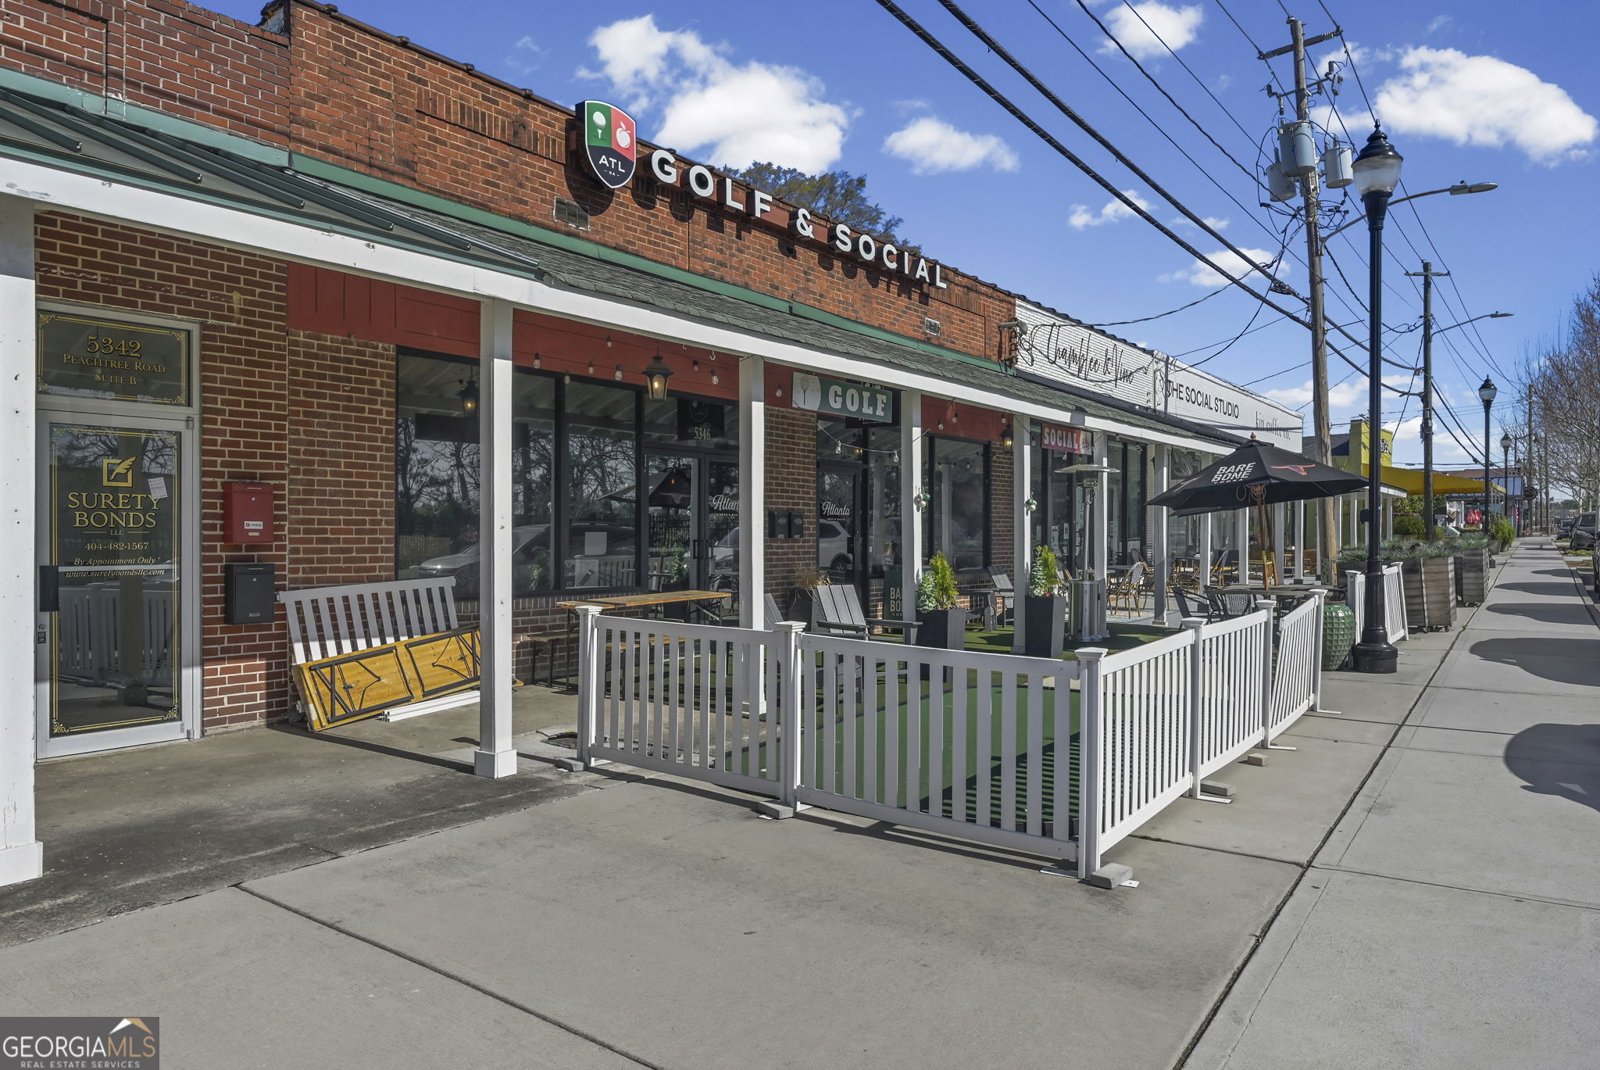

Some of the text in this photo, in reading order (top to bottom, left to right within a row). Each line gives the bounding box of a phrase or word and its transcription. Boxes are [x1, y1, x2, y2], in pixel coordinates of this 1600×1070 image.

[598, 154, 626, 173] ATL
[651, 149, 947, 289] GOLF & SOCIAL
[87, 335, 142, 358] 5342
[63, 353, 166, 373] PEACHTREE ROAD
[95, 373, 137, 385] SUITE B
[828, 384, 887, 417] GOLF
[1167, 380, 1240, 419] THE SOCIAL STUDIO
[1043, 427, 1077, 449] SOCIAL
[1211, 470, 1252, 482] BONE
[1216, 461, 1256, 475] BARE
[68, 492, 160, 510] SURETY
[712, 494, 740, 511] Atlan
[821, 501, 850, 516] Atlanta
[74, 511, 157, 528] BONDS
[85, 542, 149, 551] 404-482-1567
[73, 557, 85, 566] By
[86, 557, 136, 566] Appointment
